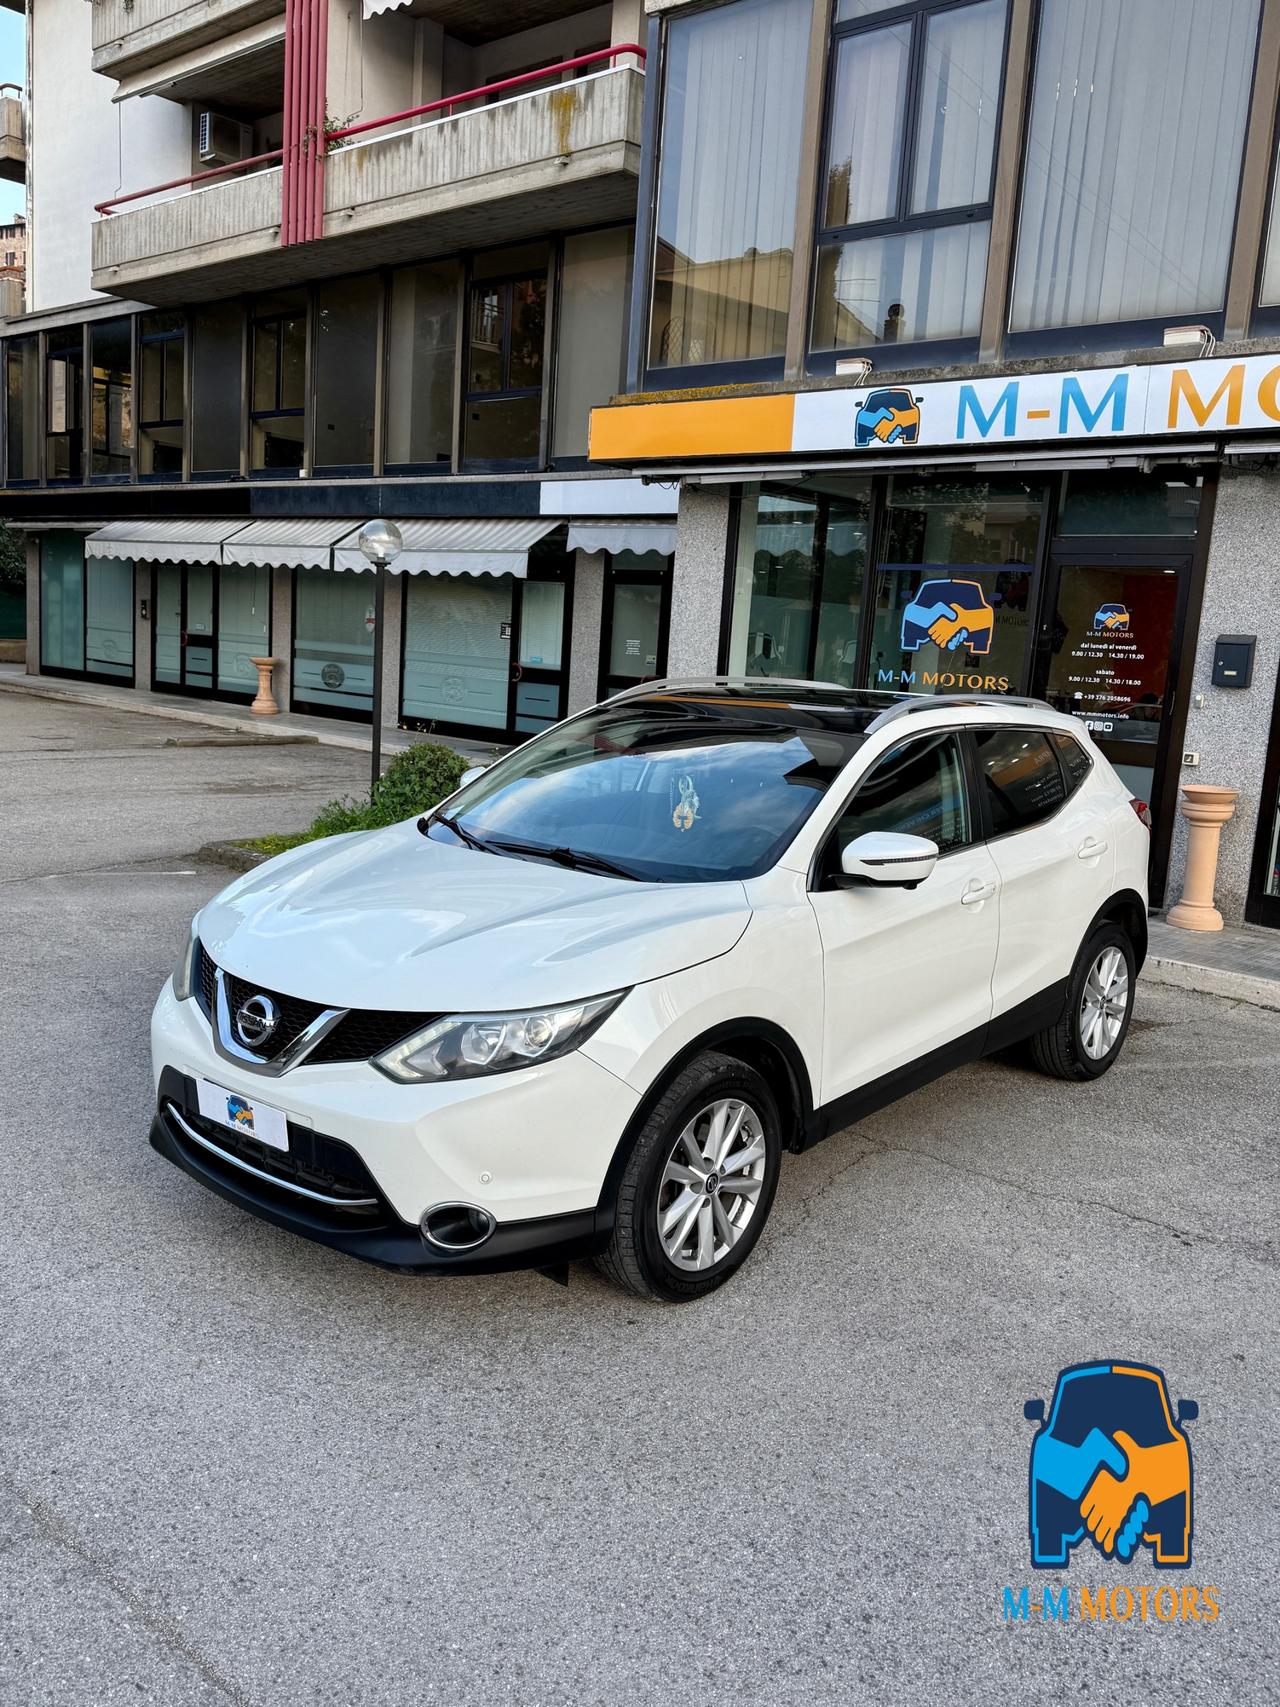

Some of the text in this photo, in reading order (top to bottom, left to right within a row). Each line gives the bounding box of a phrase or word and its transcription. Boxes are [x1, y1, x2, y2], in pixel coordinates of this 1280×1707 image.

[956, 374, 1129, 439] M-M
[878, 669, 1009, 691] M-M MOTORS
[1071, 710, 1130, 719] www.mmmotors.info
